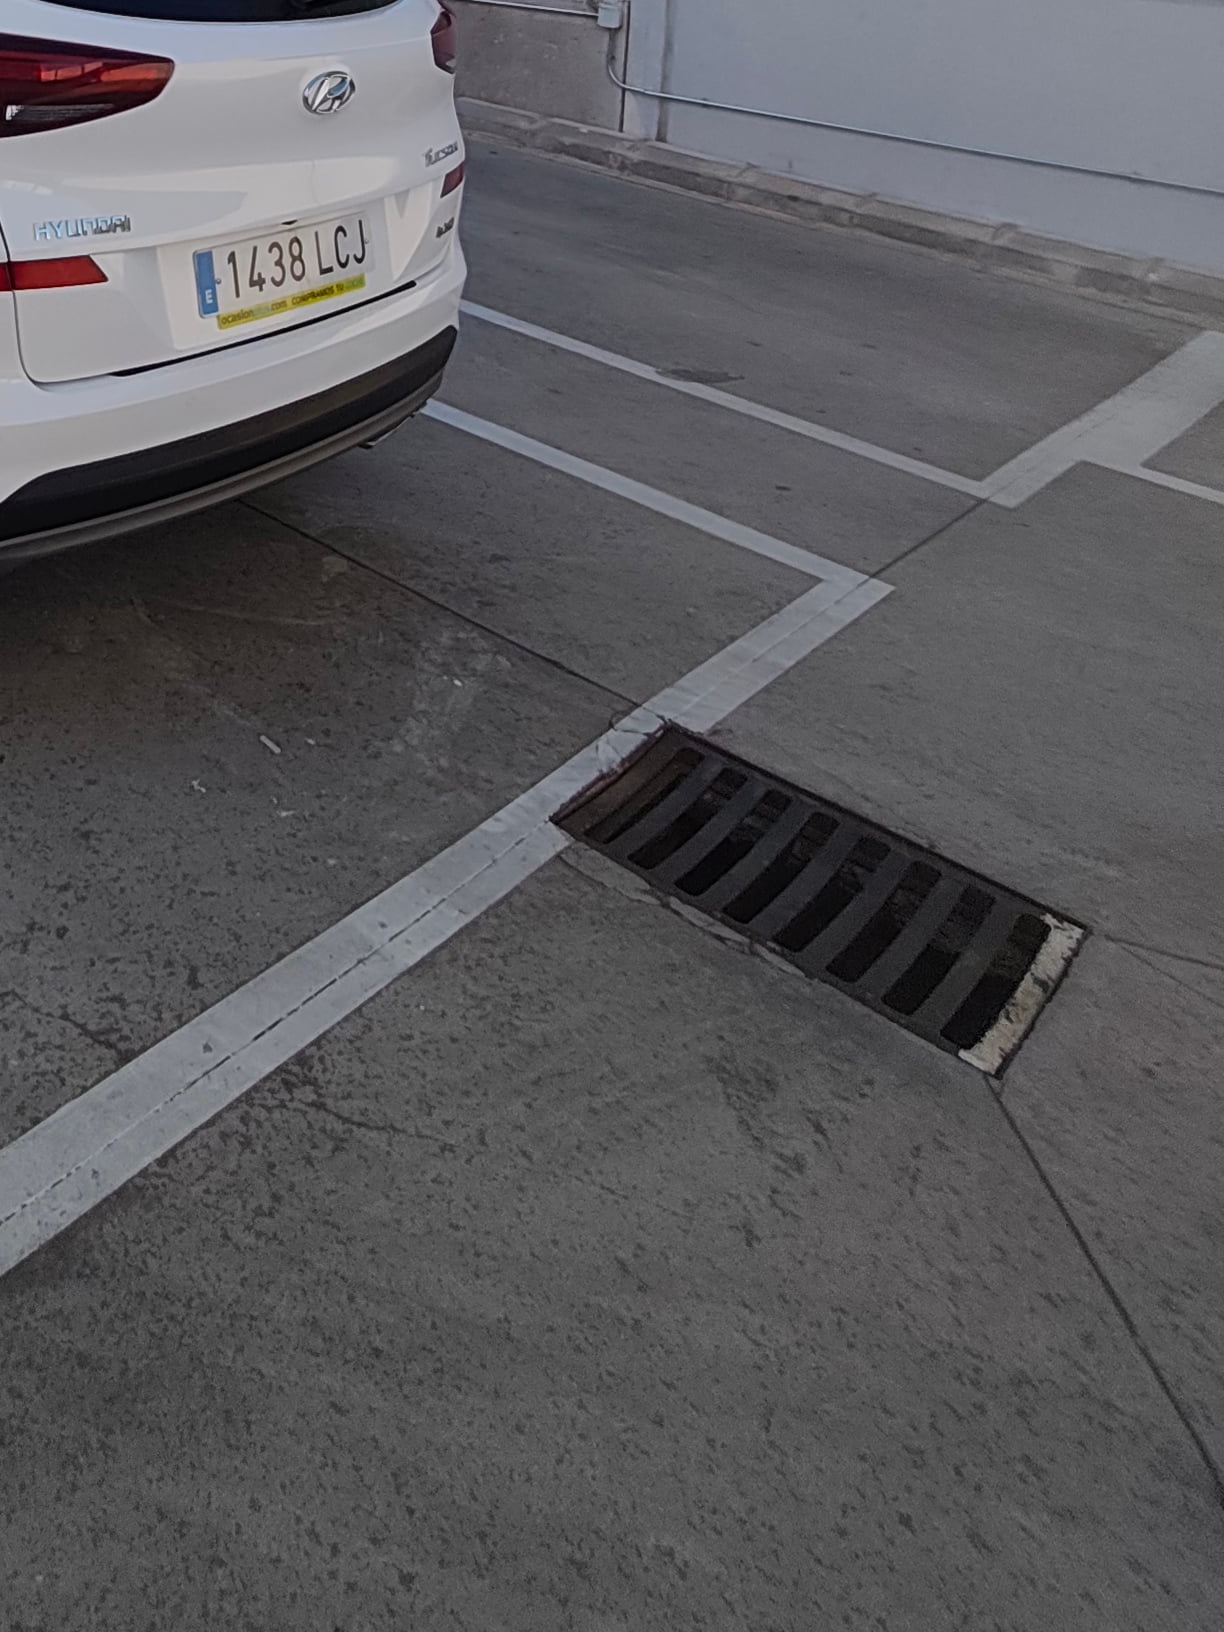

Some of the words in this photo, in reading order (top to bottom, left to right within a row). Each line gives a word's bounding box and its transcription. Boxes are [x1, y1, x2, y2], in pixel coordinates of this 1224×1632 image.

[32, 214, 131, 241] HYUNDAI
[227, 236, 306, 299] 1438
[314, 219, 366, 276] LCJ
[205, 289, 213, 304] E
